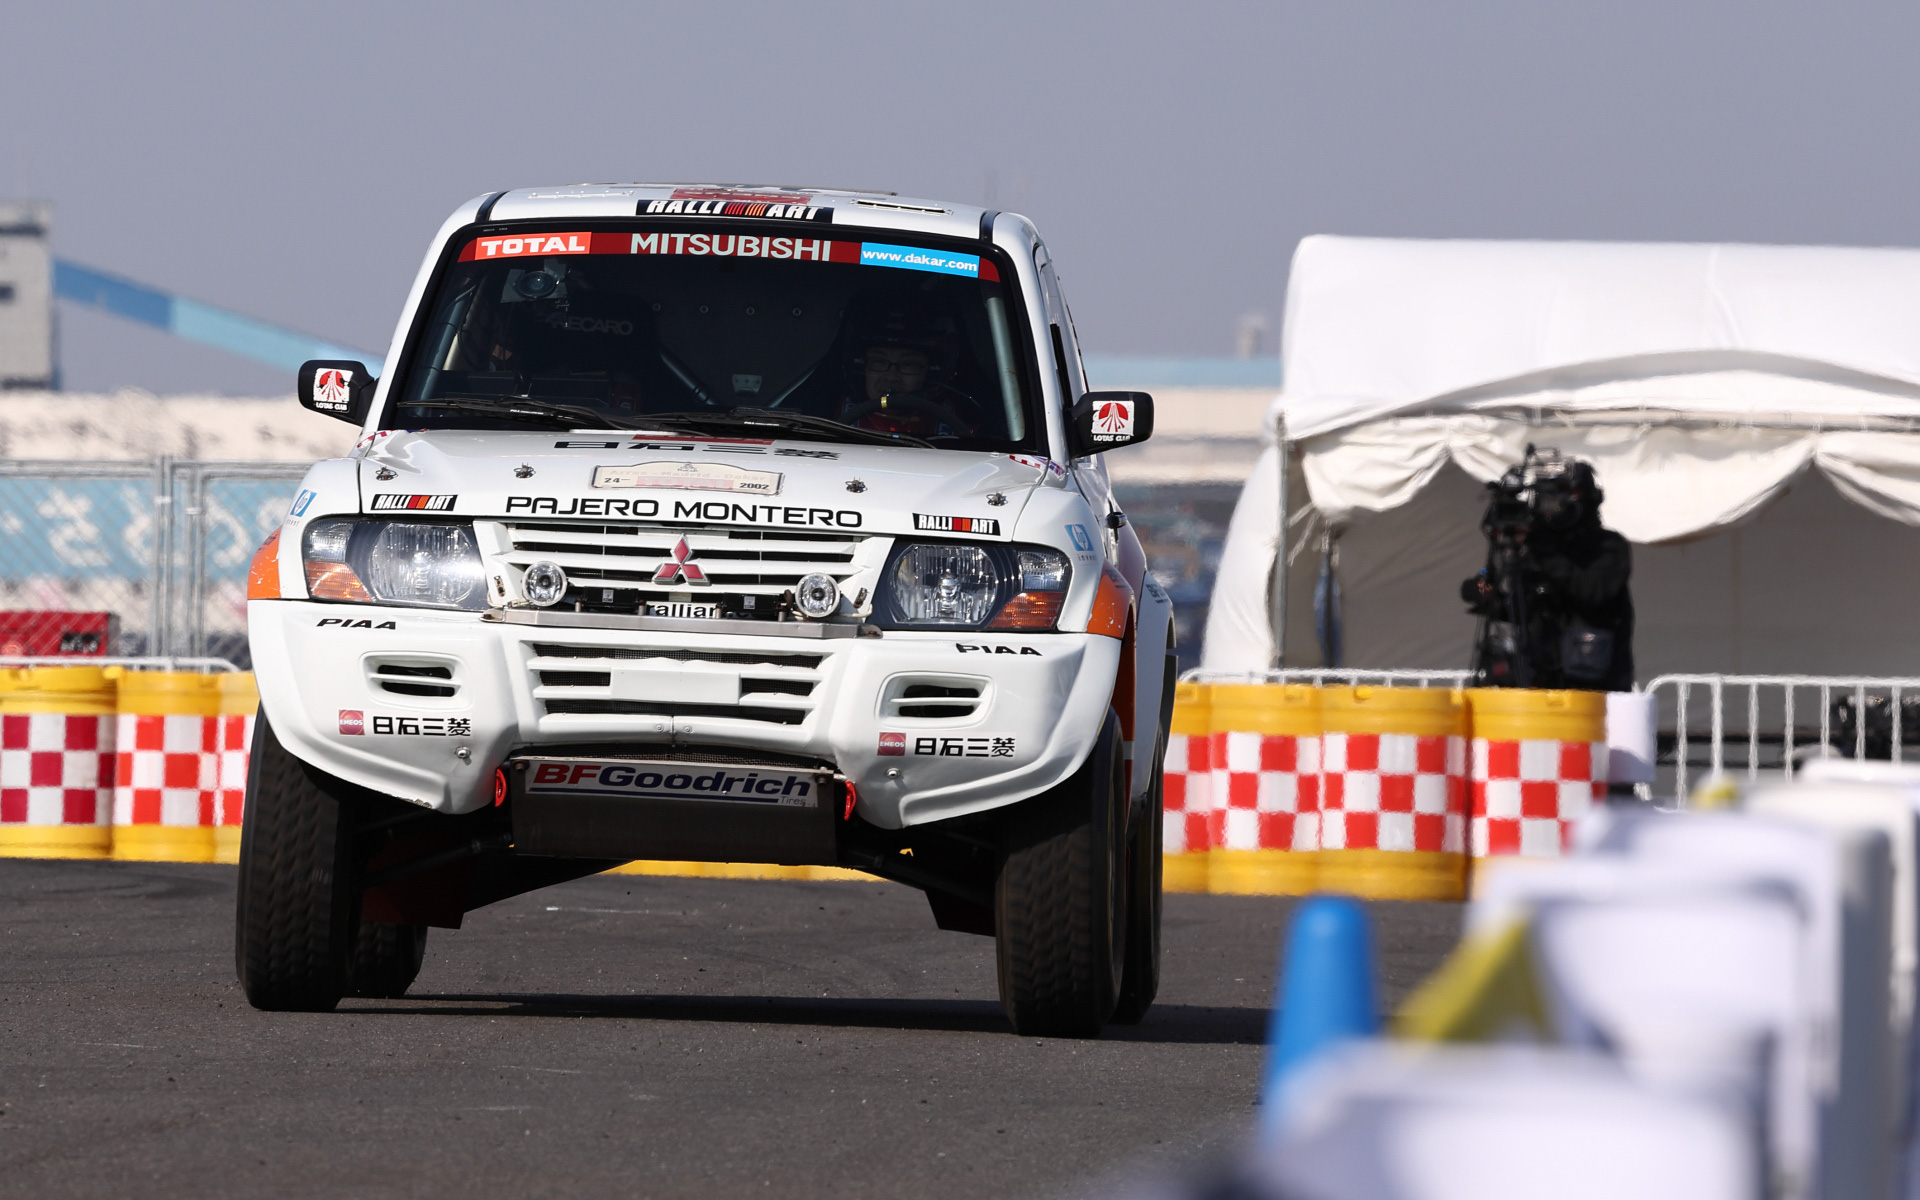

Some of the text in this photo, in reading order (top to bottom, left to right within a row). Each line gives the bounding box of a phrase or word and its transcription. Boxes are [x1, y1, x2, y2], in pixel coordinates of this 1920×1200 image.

[646, 200, 825, 220] RALLI ART
[481, 235, 587, 256] TOTAL
[630, 233, 832, 262] MITSUBISHI
[862, 250, 978, 272] www.dakar.com
[739, 482, 770, 490] 2002
[374, 495, 454, 510] RALLI ART
[505, 496, 863, 528] PAJERO MONTERO
[918, 515, 995, 535] RALLI ART
[316, 618, 396, 631] PIAA
[955, 643, 1043, 657] PIAA
[373, 716, 471, 737] 日石三菱
[879, 740, 905, 748] ENEOS
[914, 737, 1016, 758] 日石三菱
[532, 763, 811, 797] BFGoodrich
[780, 796, 806, 806] Tires
